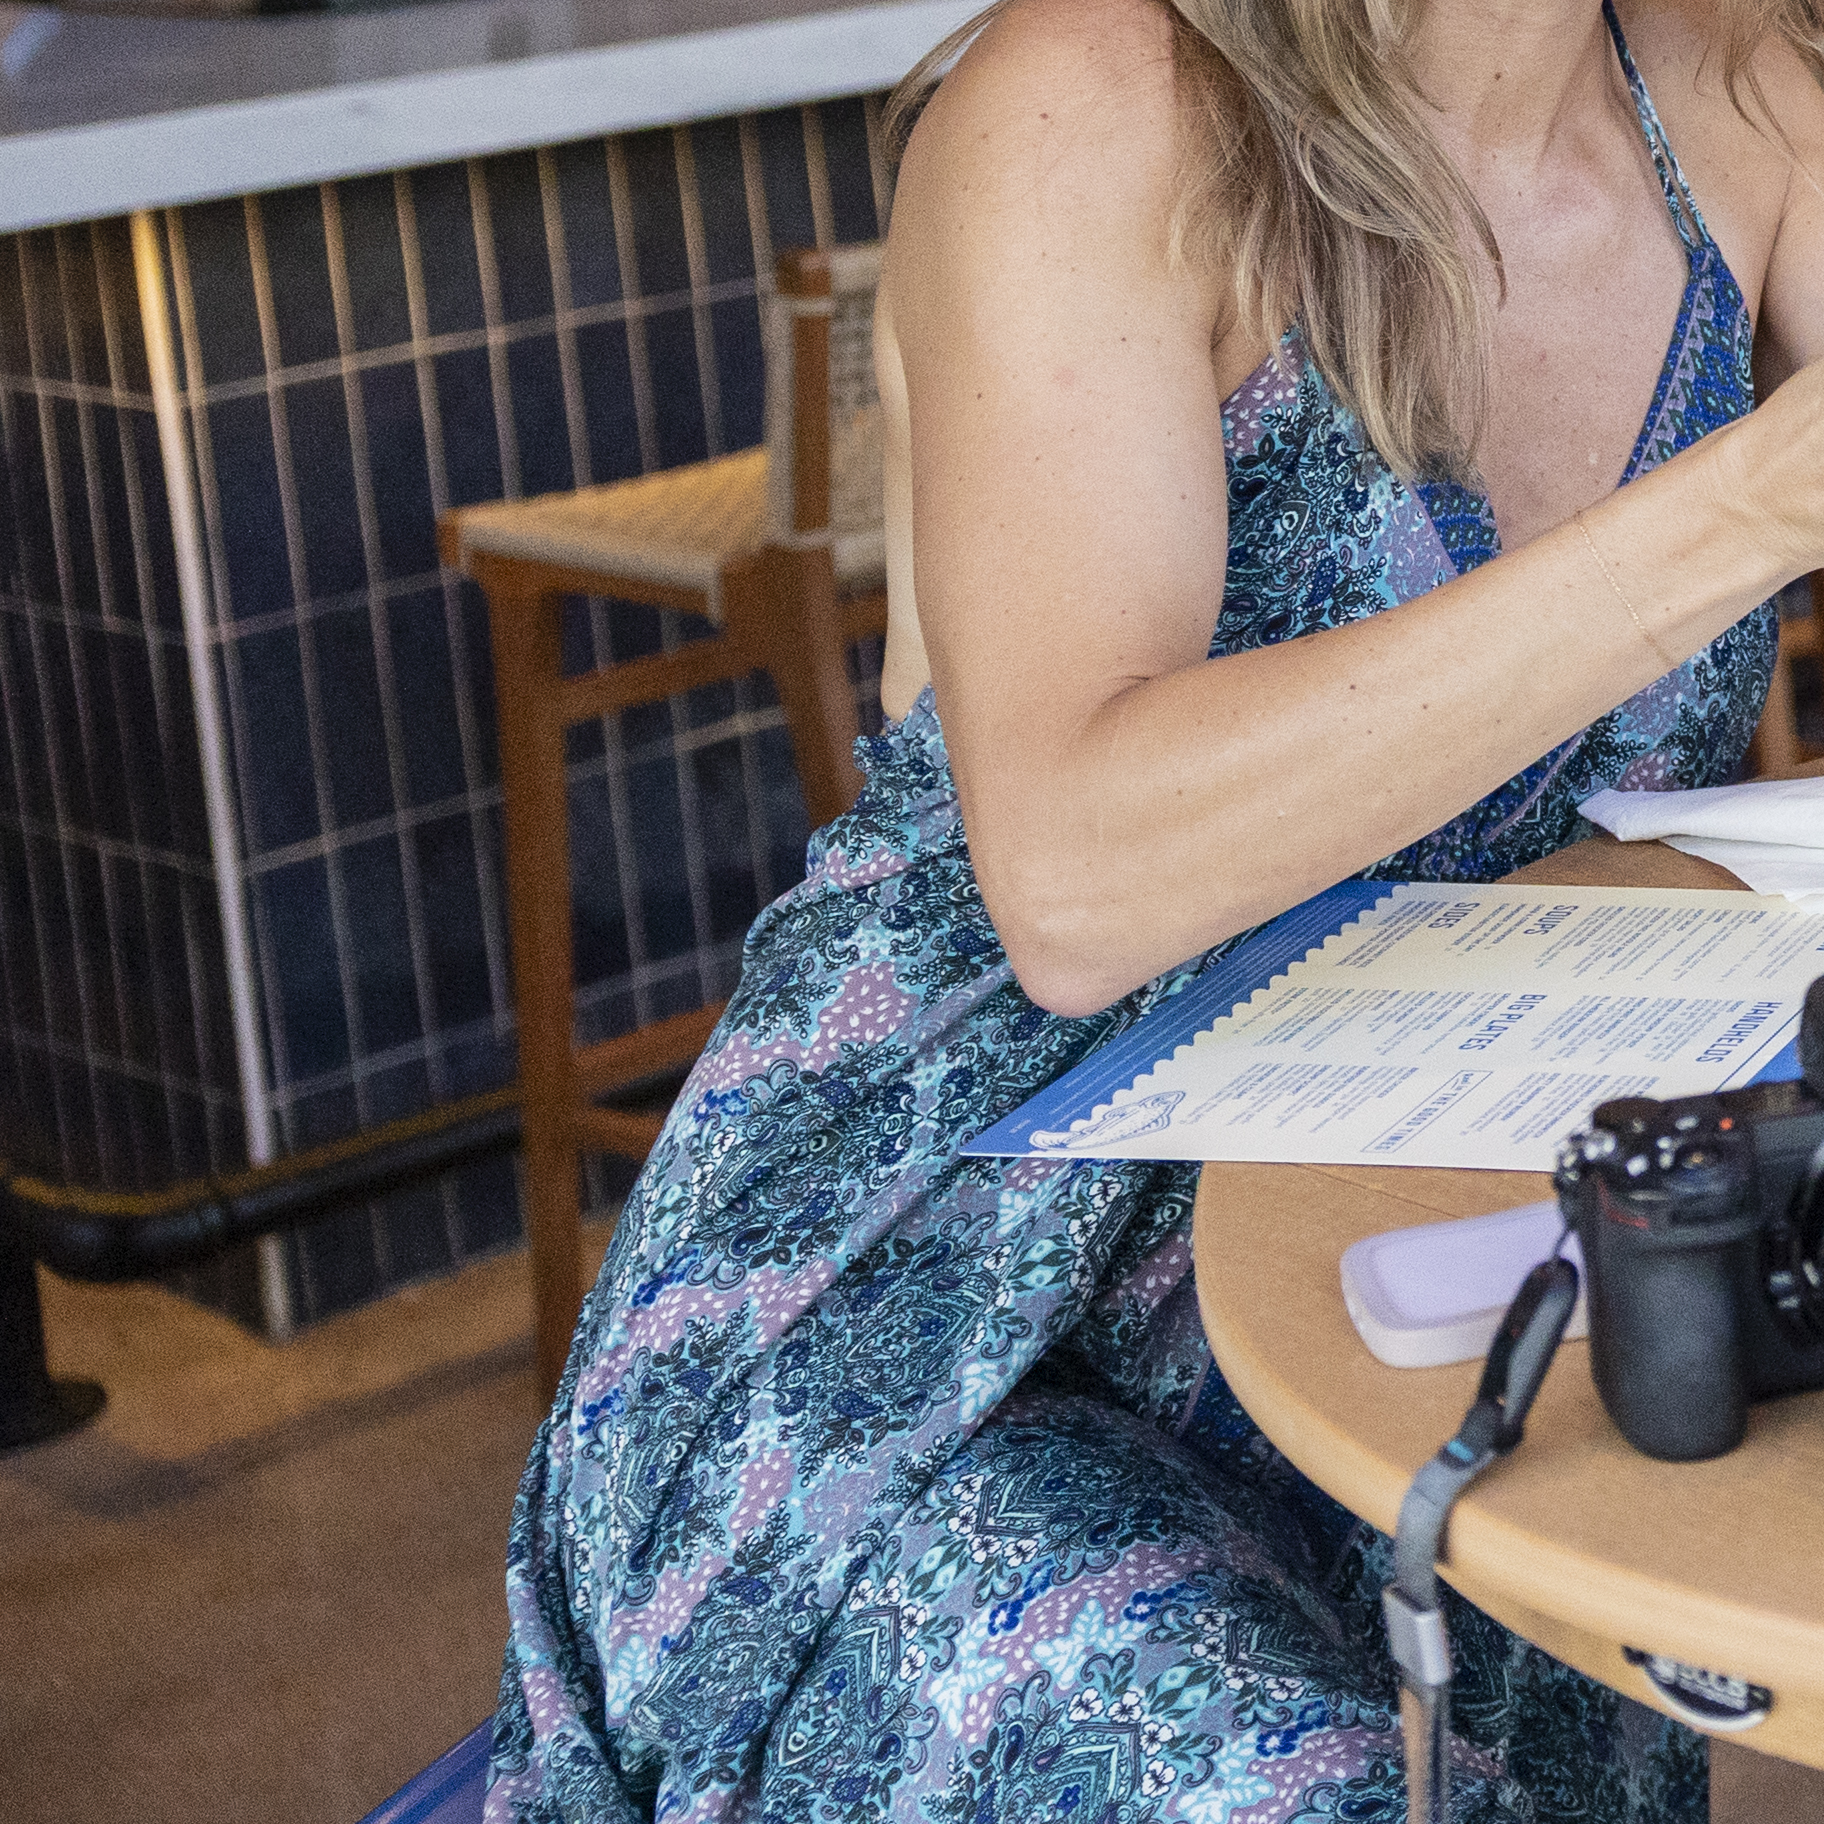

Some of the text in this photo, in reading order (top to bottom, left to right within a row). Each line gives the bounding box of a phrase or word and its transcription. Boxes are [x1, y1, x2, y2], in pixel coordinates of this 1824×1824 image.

[1423, 902, 1484, 928] SIDES
[1519, 905, 1582, 934] SOUPS
[1454, 993, 1550, 1050] BIG PLATES
[1692, 1001, 1784, 1062] HANDHELDS
[1429, 1092, 1459, 1105] THE
[1403, 1107, 1440, 1126] GOOD
[1372, 1127, 1415, 1150] TIMES
